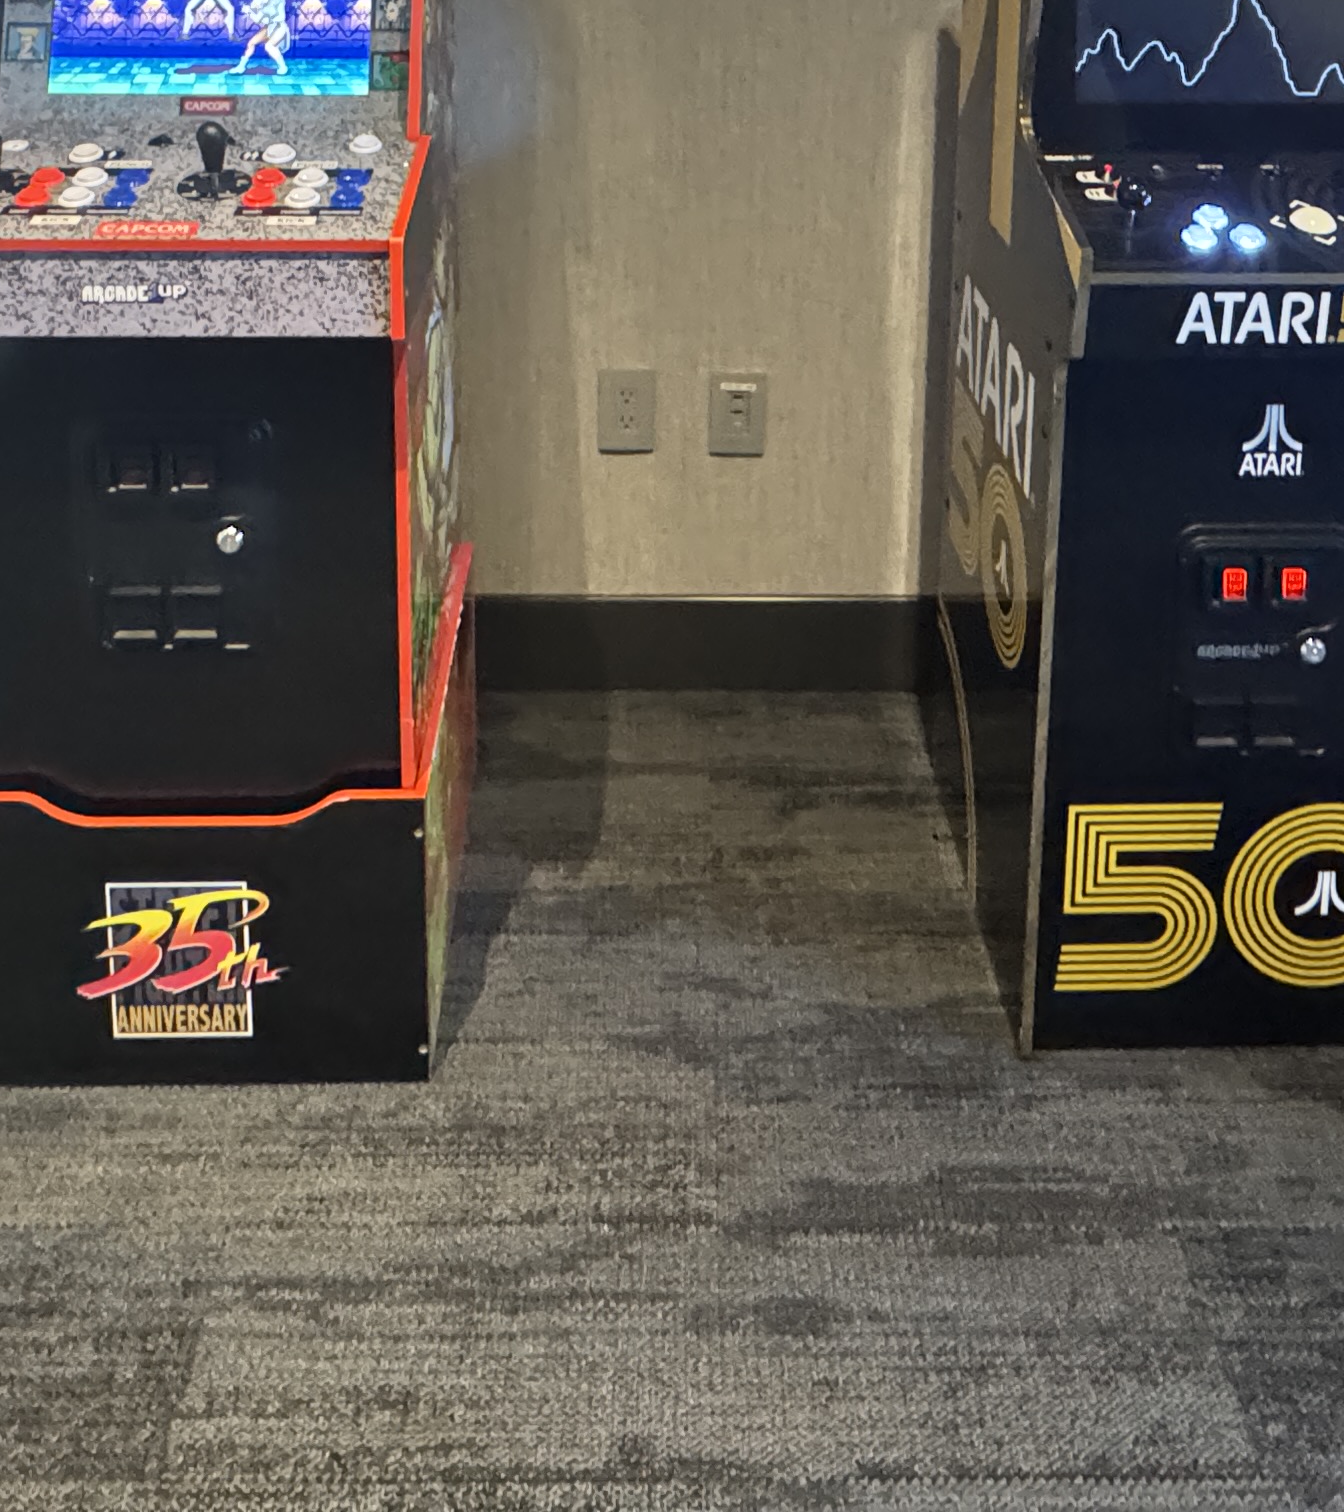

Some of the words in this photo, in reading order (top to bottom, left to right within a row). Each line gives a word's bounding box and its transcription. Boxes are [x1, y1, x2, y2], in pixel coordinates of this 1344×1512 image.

[184, 100, 232, 112] CAPCOM
[101, 223, 190, 234] CAPCOM
[1175, 291, 1332, 345] ATARI
[956, 274, 1036, 500] ATARI
[1238, 451, 1303, 477] ATARI
[117, 1003, 248, 1033] ANNIVERSARY
